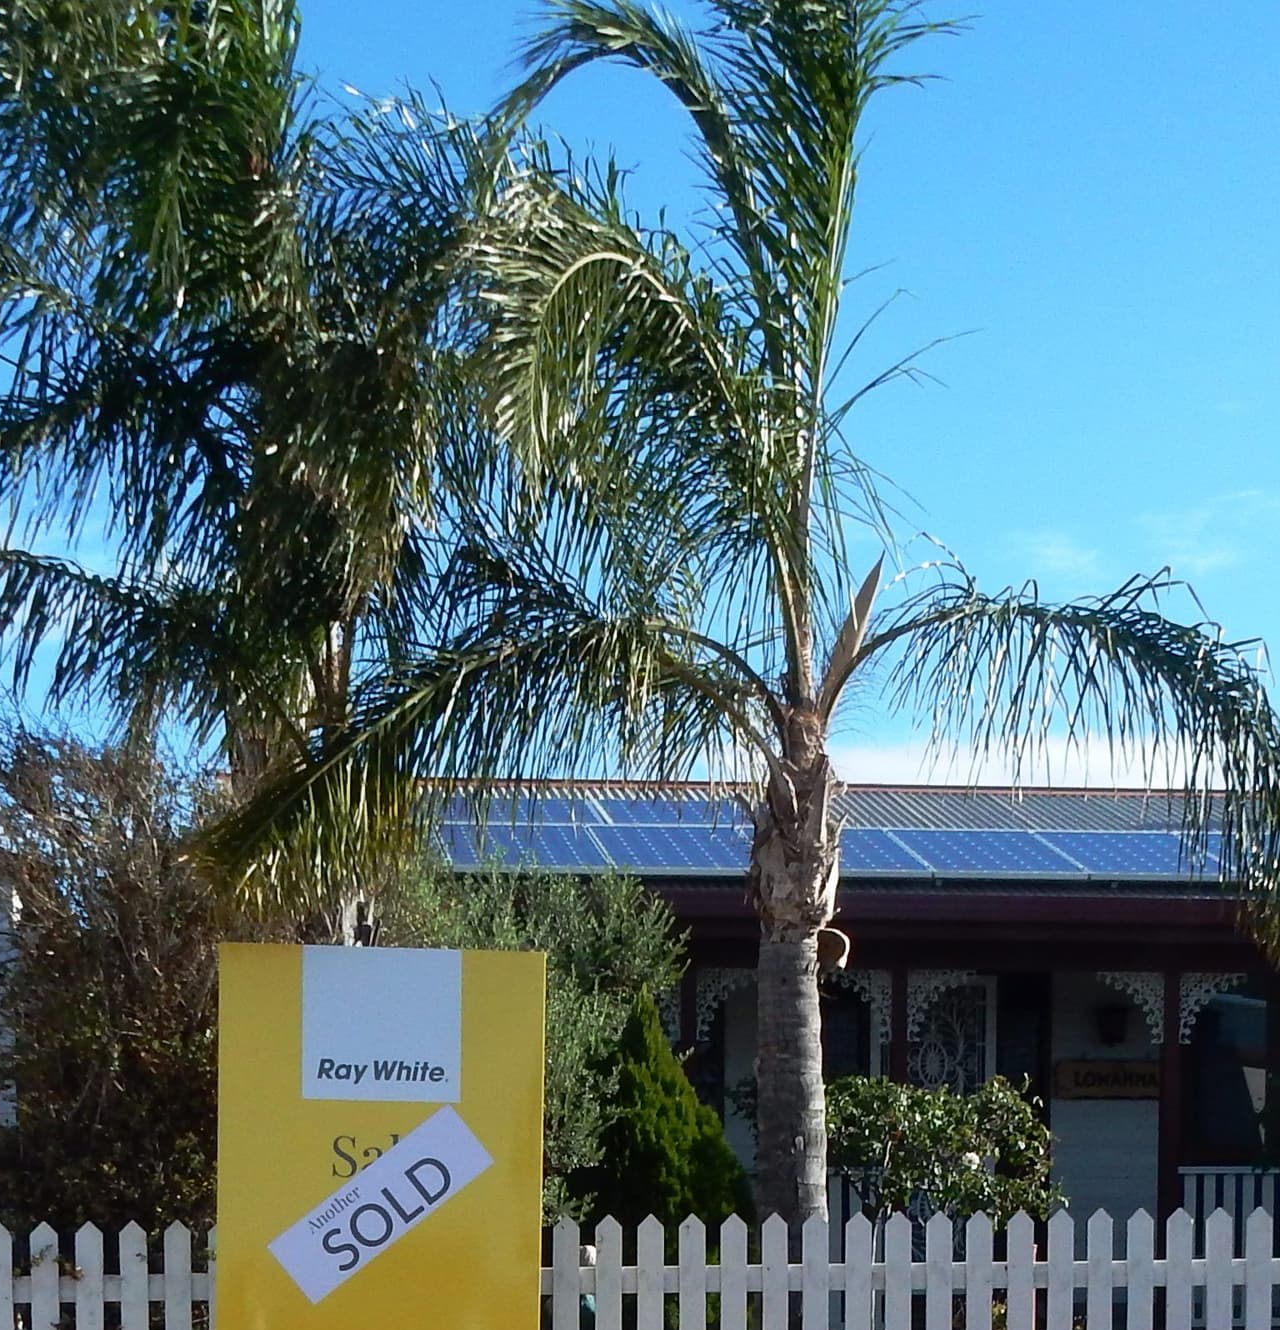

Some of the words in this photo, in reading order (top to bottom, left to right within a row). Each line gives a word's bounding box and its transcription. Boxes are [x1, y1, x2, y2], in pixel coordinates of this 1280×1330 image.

[317, 1058, 368, 1085] Ray
[331, 1133, 401, 1178] Sa
[309, 1187, 360, 1235] Another
[322, 1157, 451, 1272] SOLD
